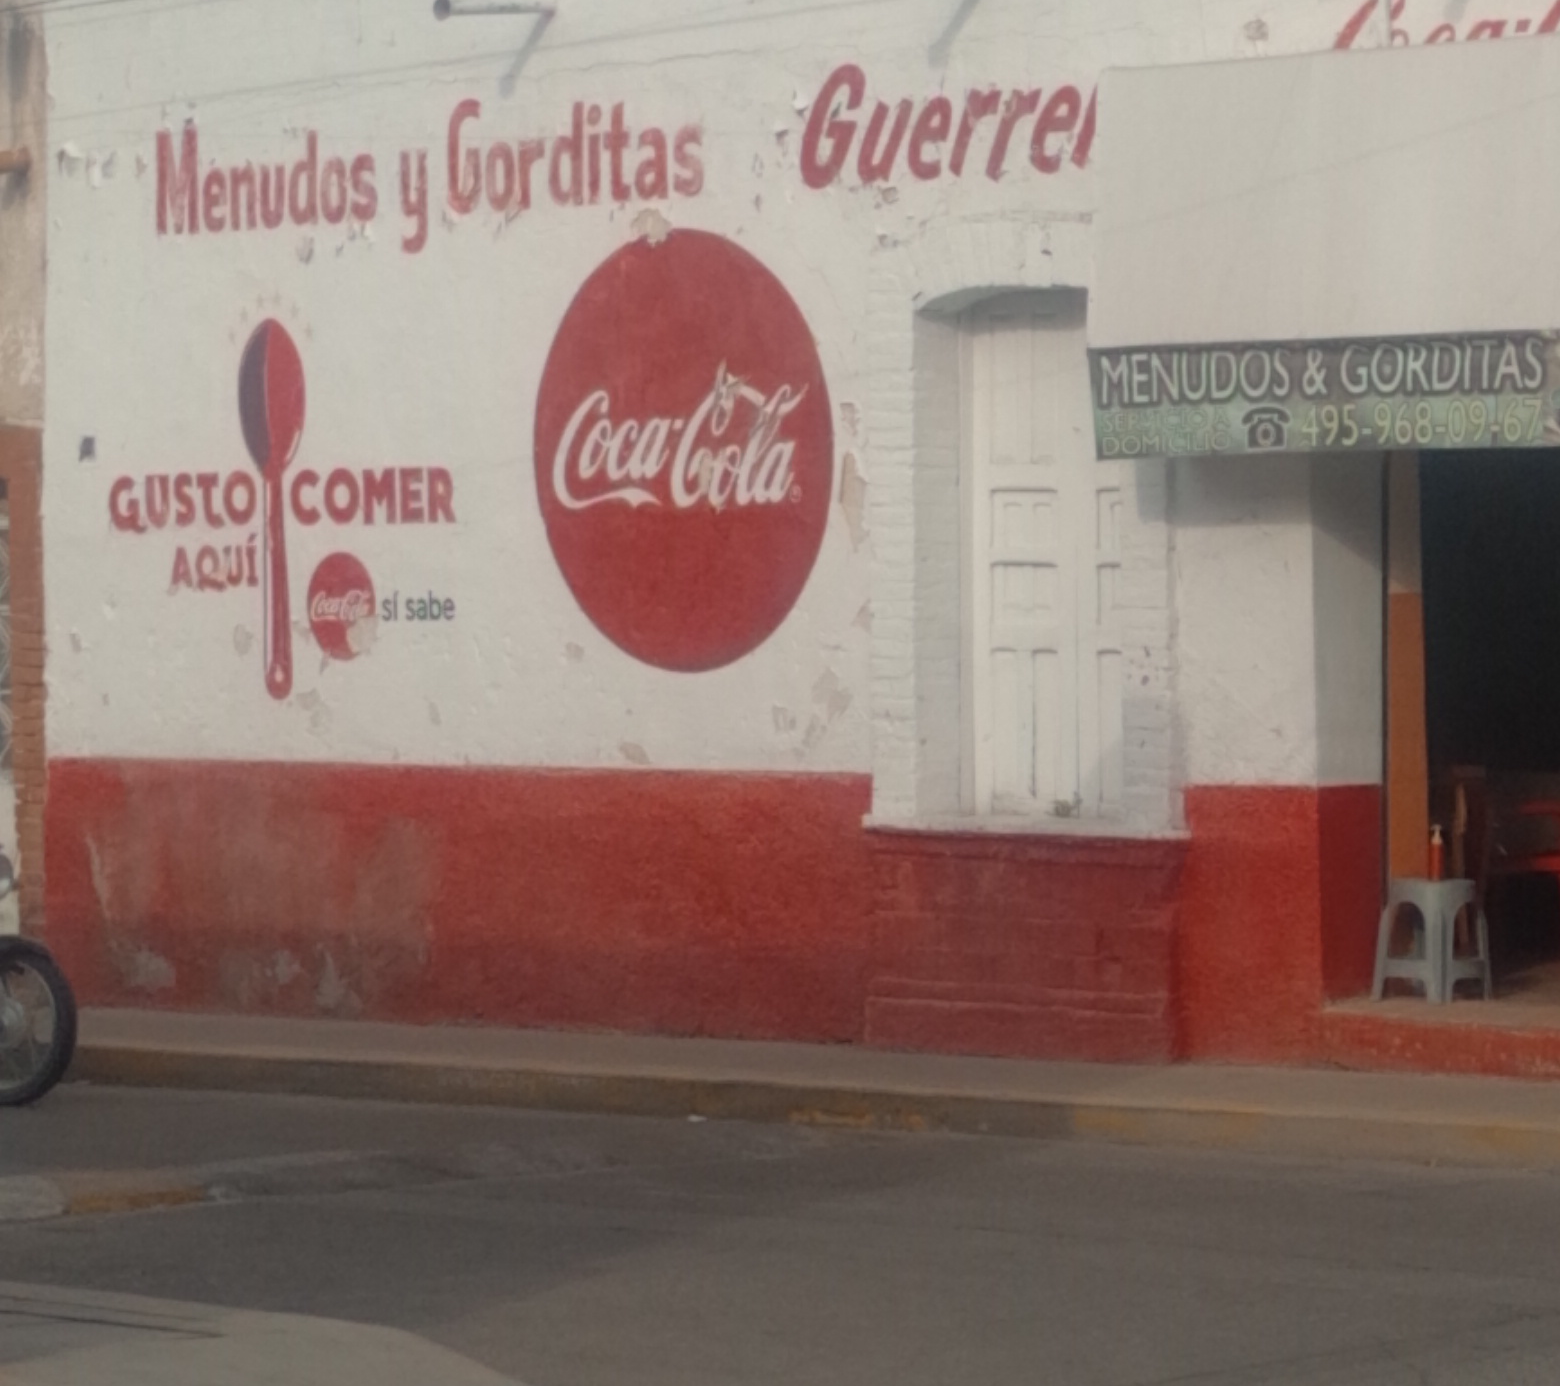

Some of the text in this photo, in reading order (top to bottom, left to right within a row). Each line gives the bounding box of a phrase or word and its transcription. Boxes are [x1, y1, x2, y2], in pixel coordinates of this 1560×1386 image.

[154, 120, 379, 237] Menudos
[400, 147, 429, 255] y
[447, 98, 706, 218] Gorditas
[1100, 338, 1544, 404] MENUDOS & GORDITAS
[552, 381, 808, 511] Coca-Cola
[1102, 431, 1232, 456] DOMICILIO
[1301, 399, 1544, 447] 495-968-09-67
[109, 466, 456, 533] GUSTO COMER
[171, 534, 260, 593] AQUÍ
[381, 589, 400, 622] sí
[405, 589, 456, 622] sabe
